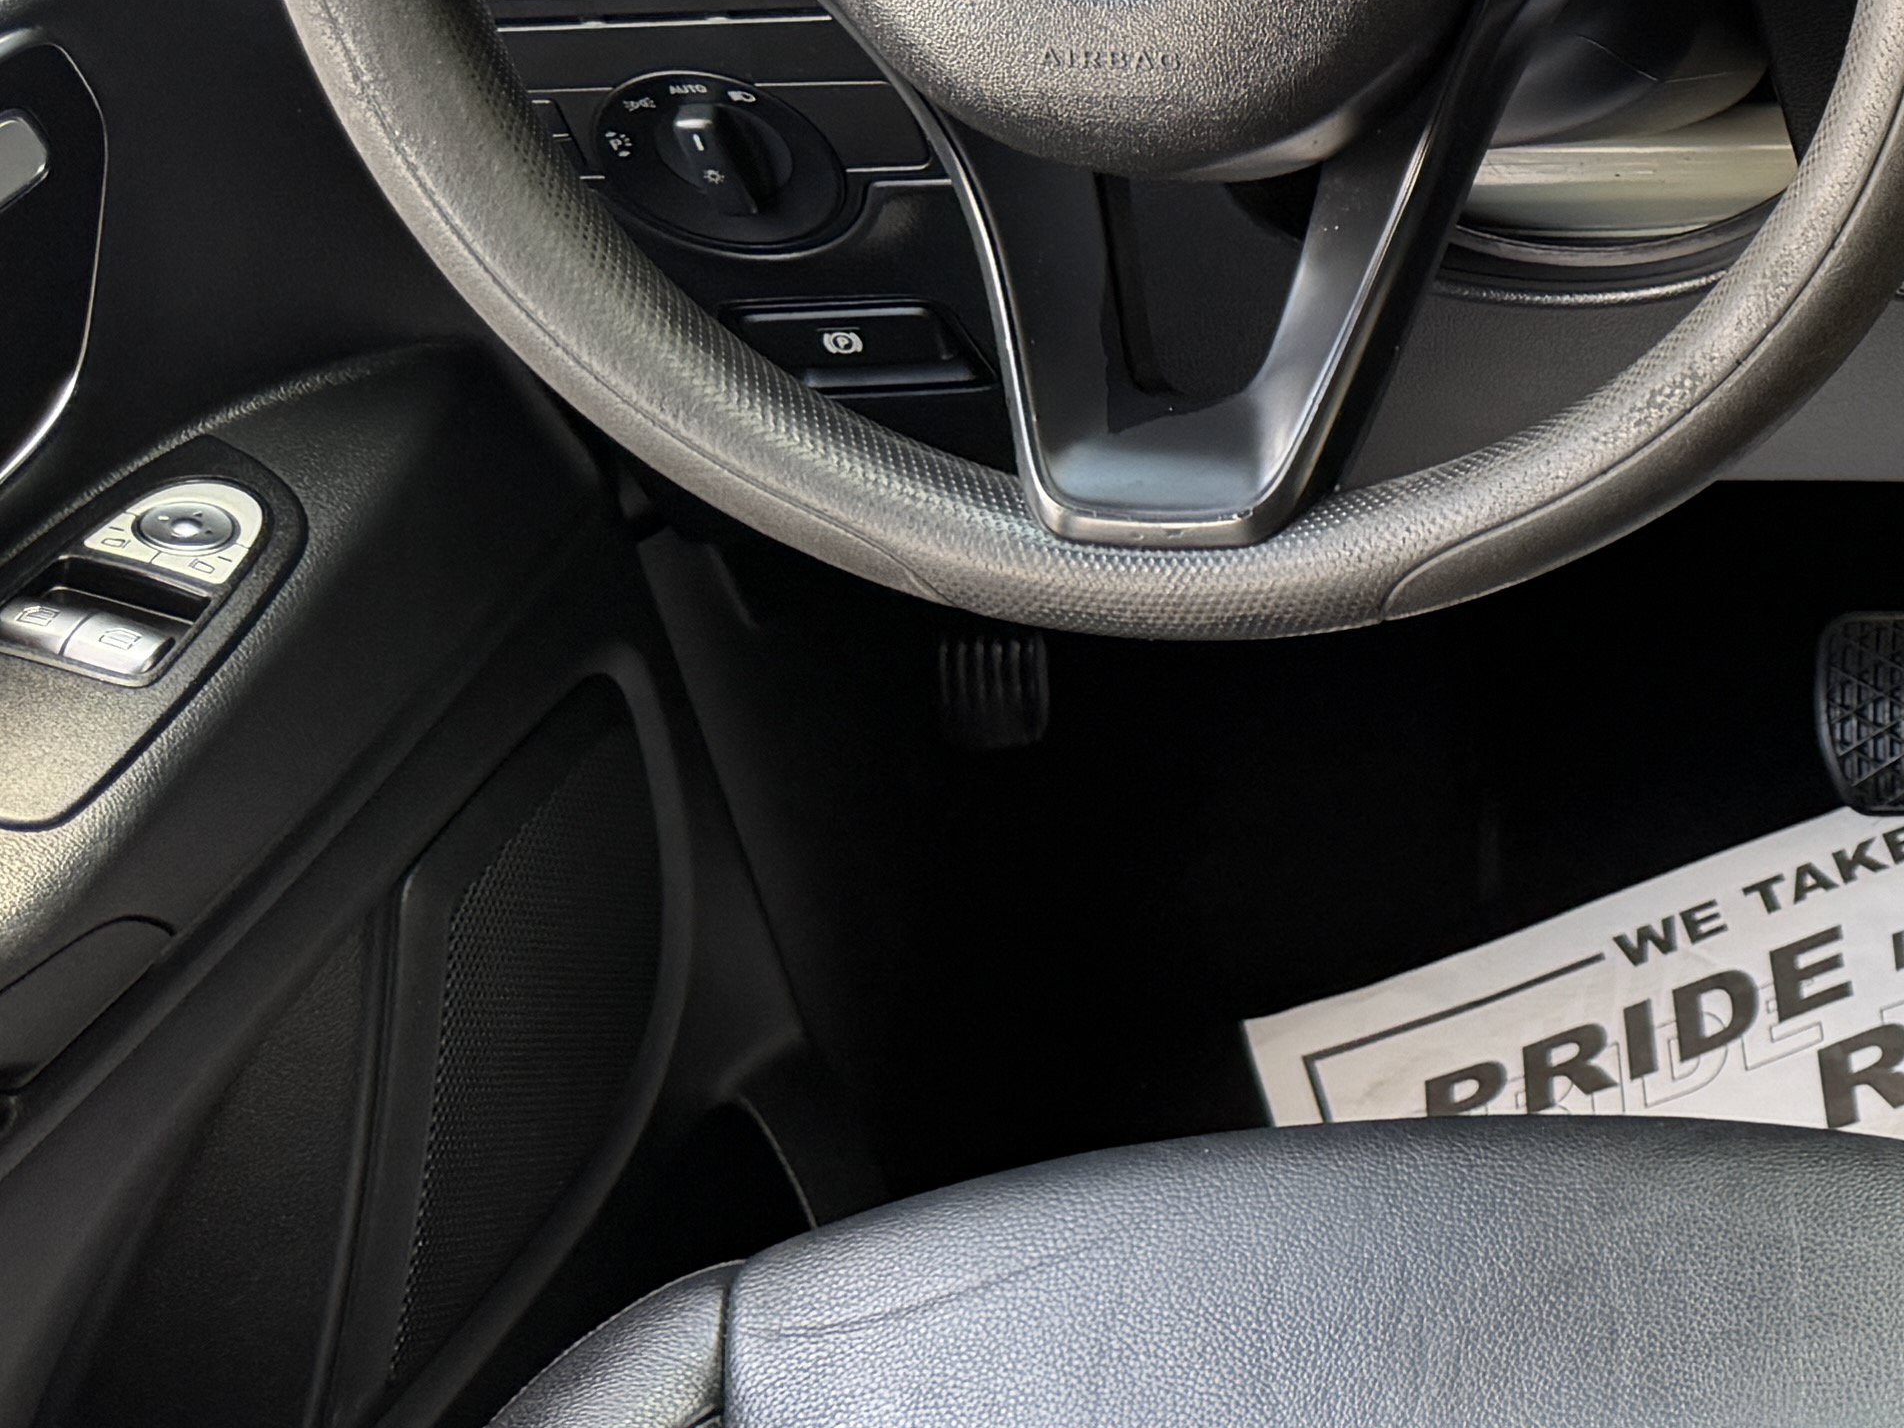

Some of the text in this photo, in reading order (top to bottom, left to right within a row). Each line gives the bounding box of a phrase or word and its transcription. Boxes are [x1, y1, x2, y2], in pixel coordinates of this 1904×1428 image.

[1042, 46, 1182, 71] AIRBAG
[669, 83, 708, 95] AUTO
[1612, 897, 1729, 968] WE
[1424, 924, 1855, 1118] PRIDE
